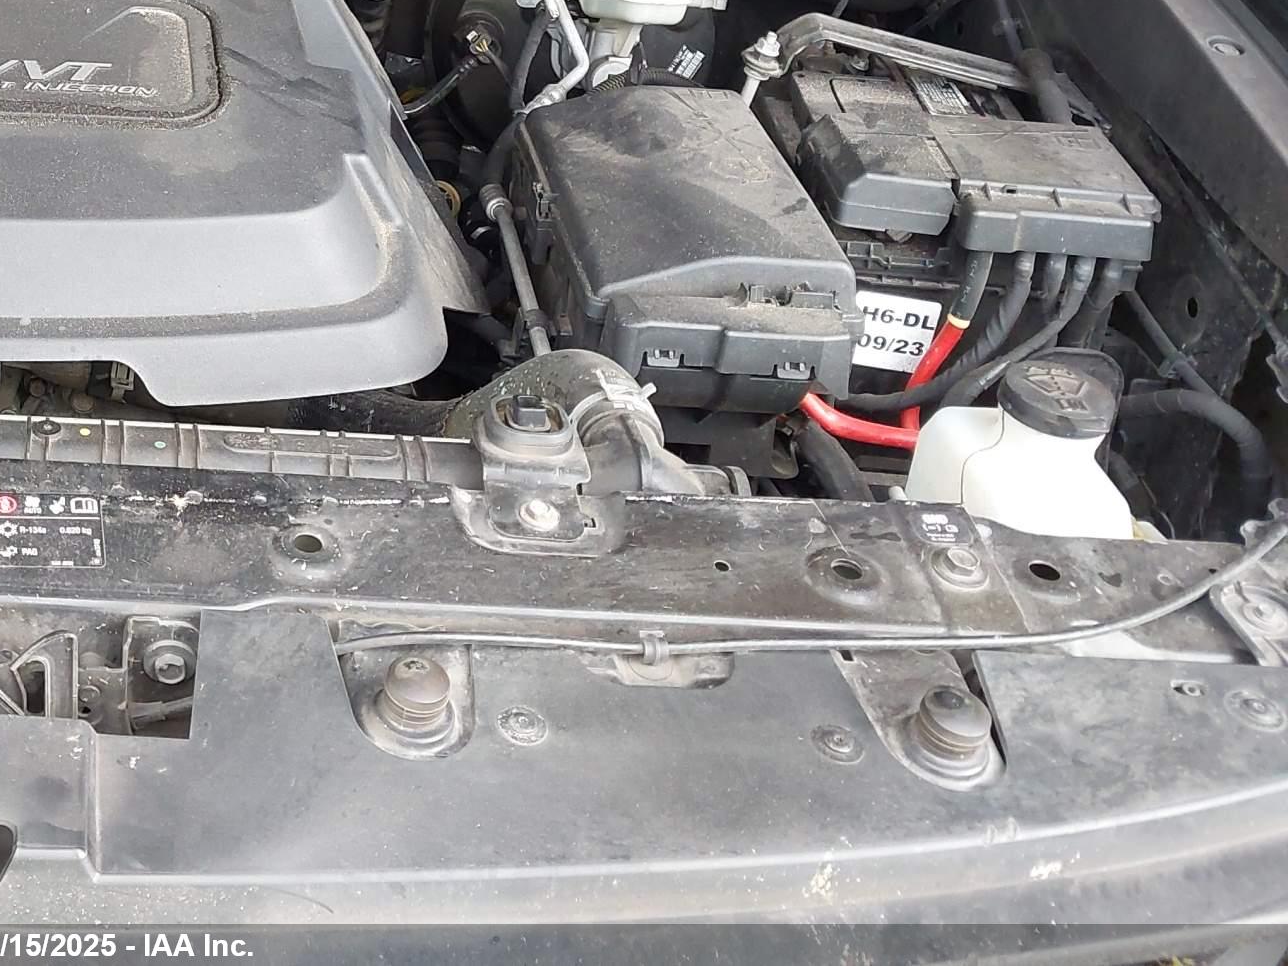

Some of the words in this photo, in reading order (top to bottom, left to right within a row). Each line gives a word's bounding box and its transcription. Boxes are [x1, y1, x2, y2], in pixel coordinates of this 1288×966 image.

[23, 82, 160, 97] INJECTION
[862, 306, 935, 330] H6-DL
[857, 333, 924, 357] 09/23
